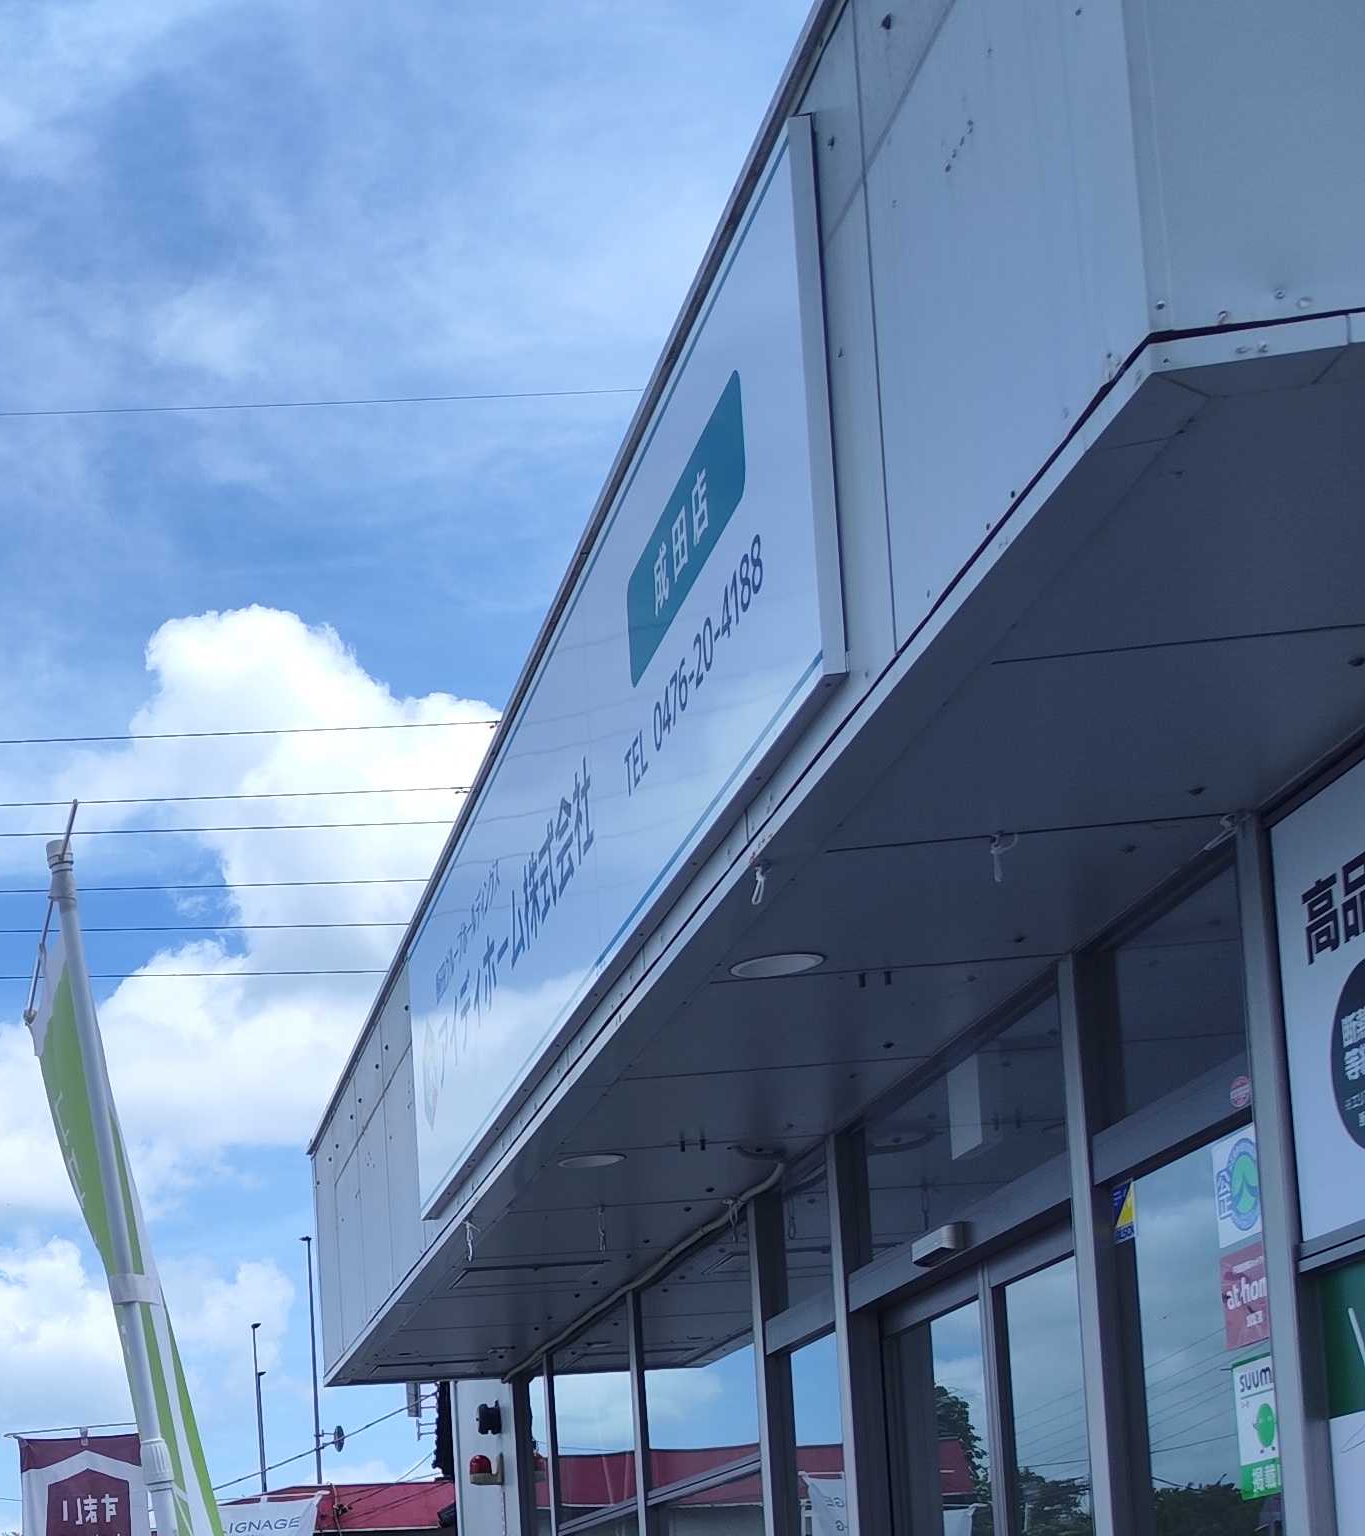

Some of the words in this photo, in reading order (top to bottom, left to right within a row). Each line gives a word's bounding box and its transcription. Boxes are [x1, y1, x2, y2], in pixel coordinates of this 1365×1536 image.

[653, 467, 709, 618] 成田店
[624, 729, 649, 798] TEL
[653, 533, 763, 753] 0476-20-4188
[439, 755, 595, 1089] アイディホーム株式会社
[223, 1516, 301, 1534] IGNAGE
